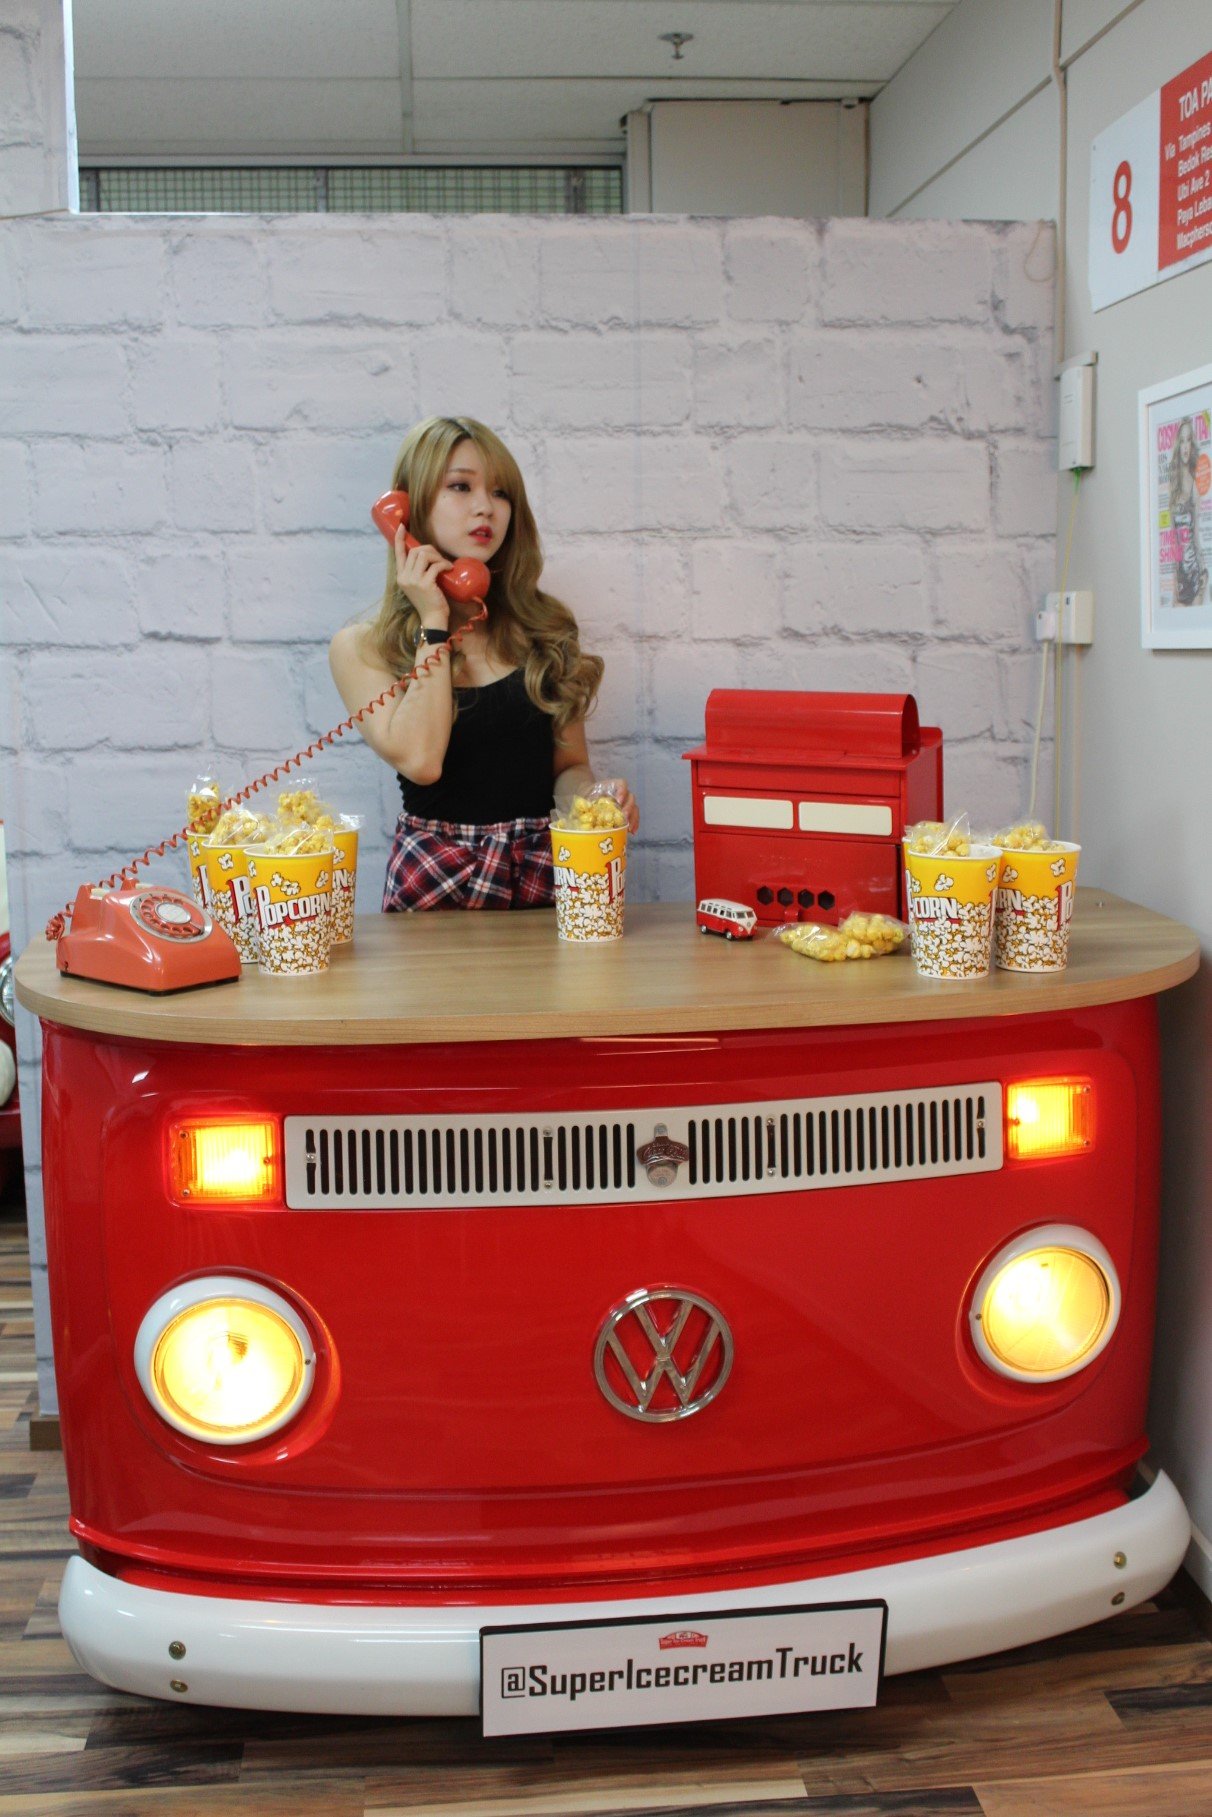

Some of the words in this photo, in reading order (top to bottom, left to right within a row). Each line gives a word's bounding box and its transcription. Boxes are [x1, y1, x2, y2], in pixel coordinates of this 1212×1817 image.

[1179, 87, 1199, 122] TOA
[1164, 142, 1176, 162] Via
[1179, 121, 1212, 153] Tampines
[1178, 151, 1200, 178] Bedok
[1190, 176, 1205, 196] Ave
[1203, 169, 1210, 187] 2
[1111, 160, 1133, 254] 8
[1177, 206, 1194, 227] Paya
[255, 885, 330, 928] POPCORN
[501, 1642, 864, 1701] @SuperIcecreamTruck
